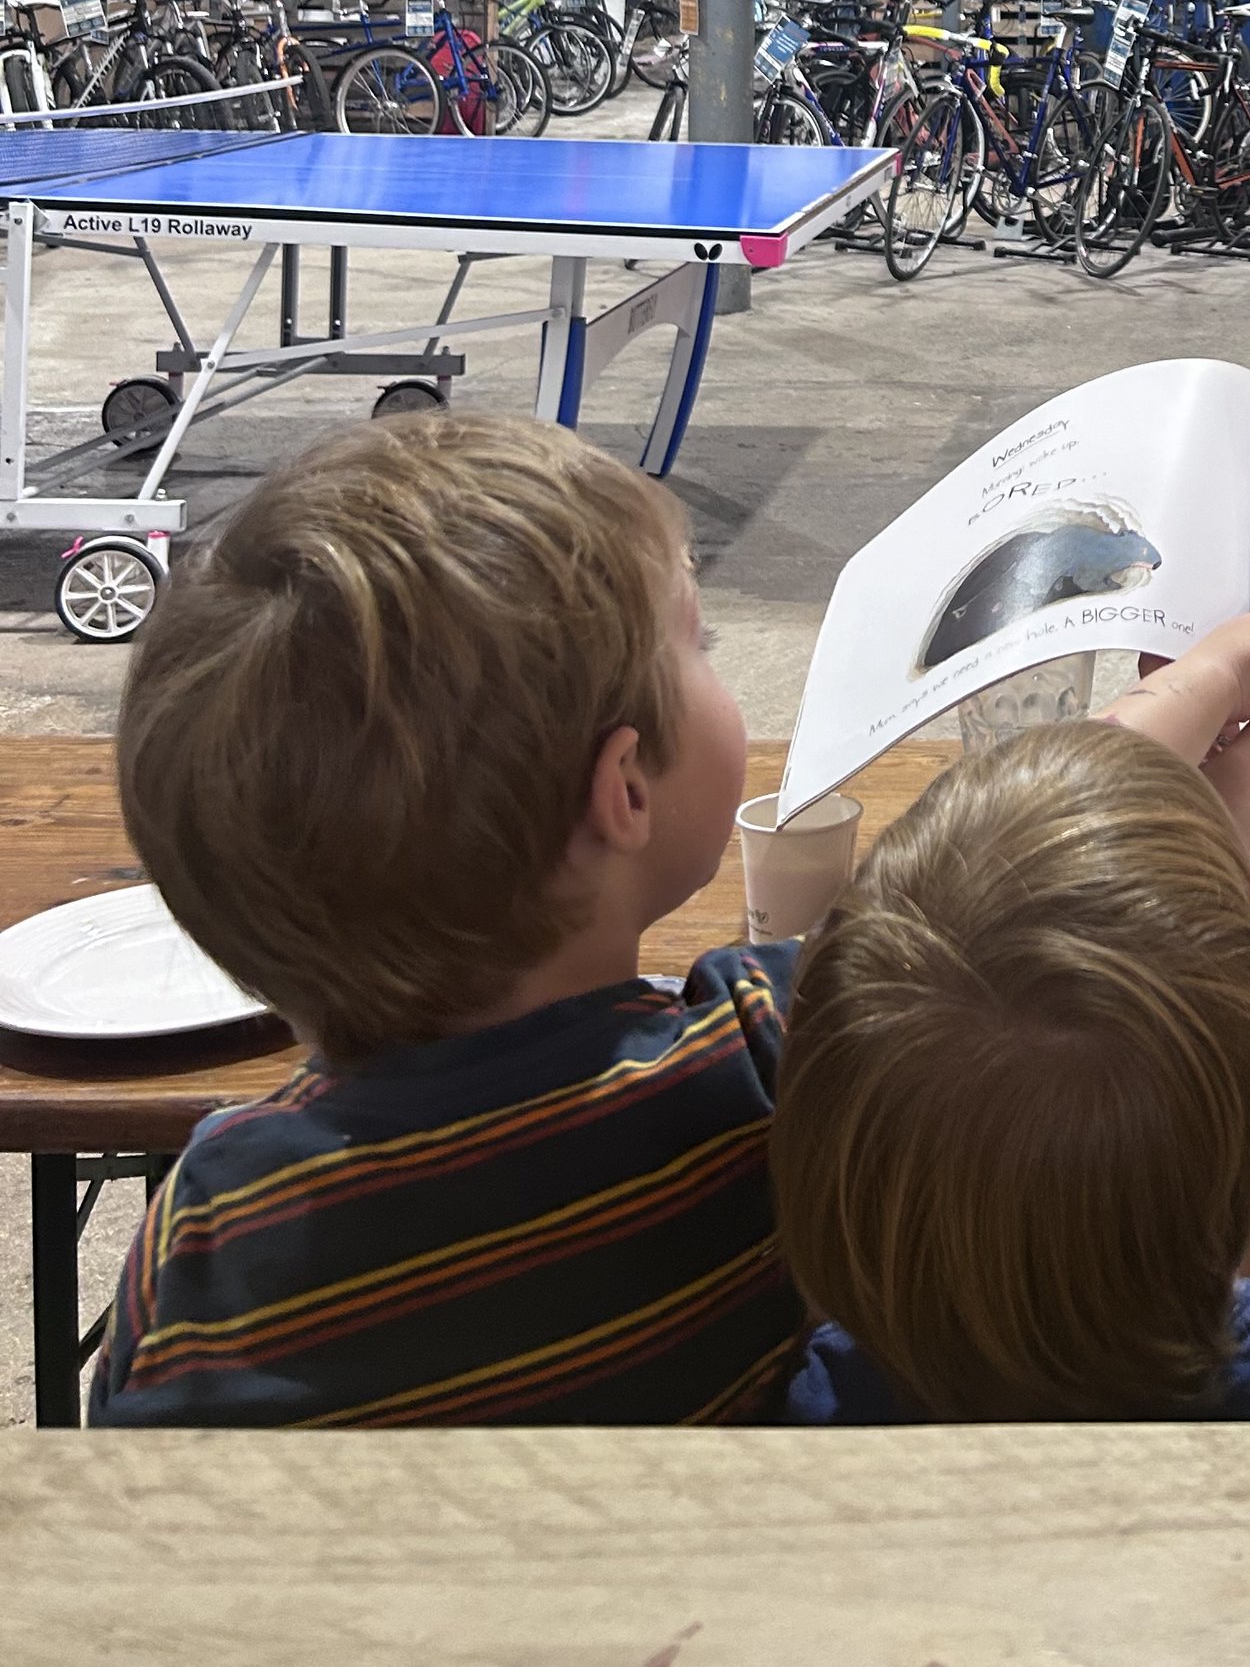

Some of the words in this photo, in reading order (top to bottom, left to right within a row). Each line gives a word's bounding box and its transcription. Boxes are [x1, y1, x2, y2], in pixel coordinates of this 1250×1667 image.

[64, 215, 122, 232] Active
[128, 218, 161, 234] L19
[168, 219, 252, 240] Rollaway
[992, 419, 1070, 468] Wednesday
[1064, 616, 1075, 629] A
[1082, 606, 1166, 627] BIGGER
[1171, 622, 1195, 635] one!
